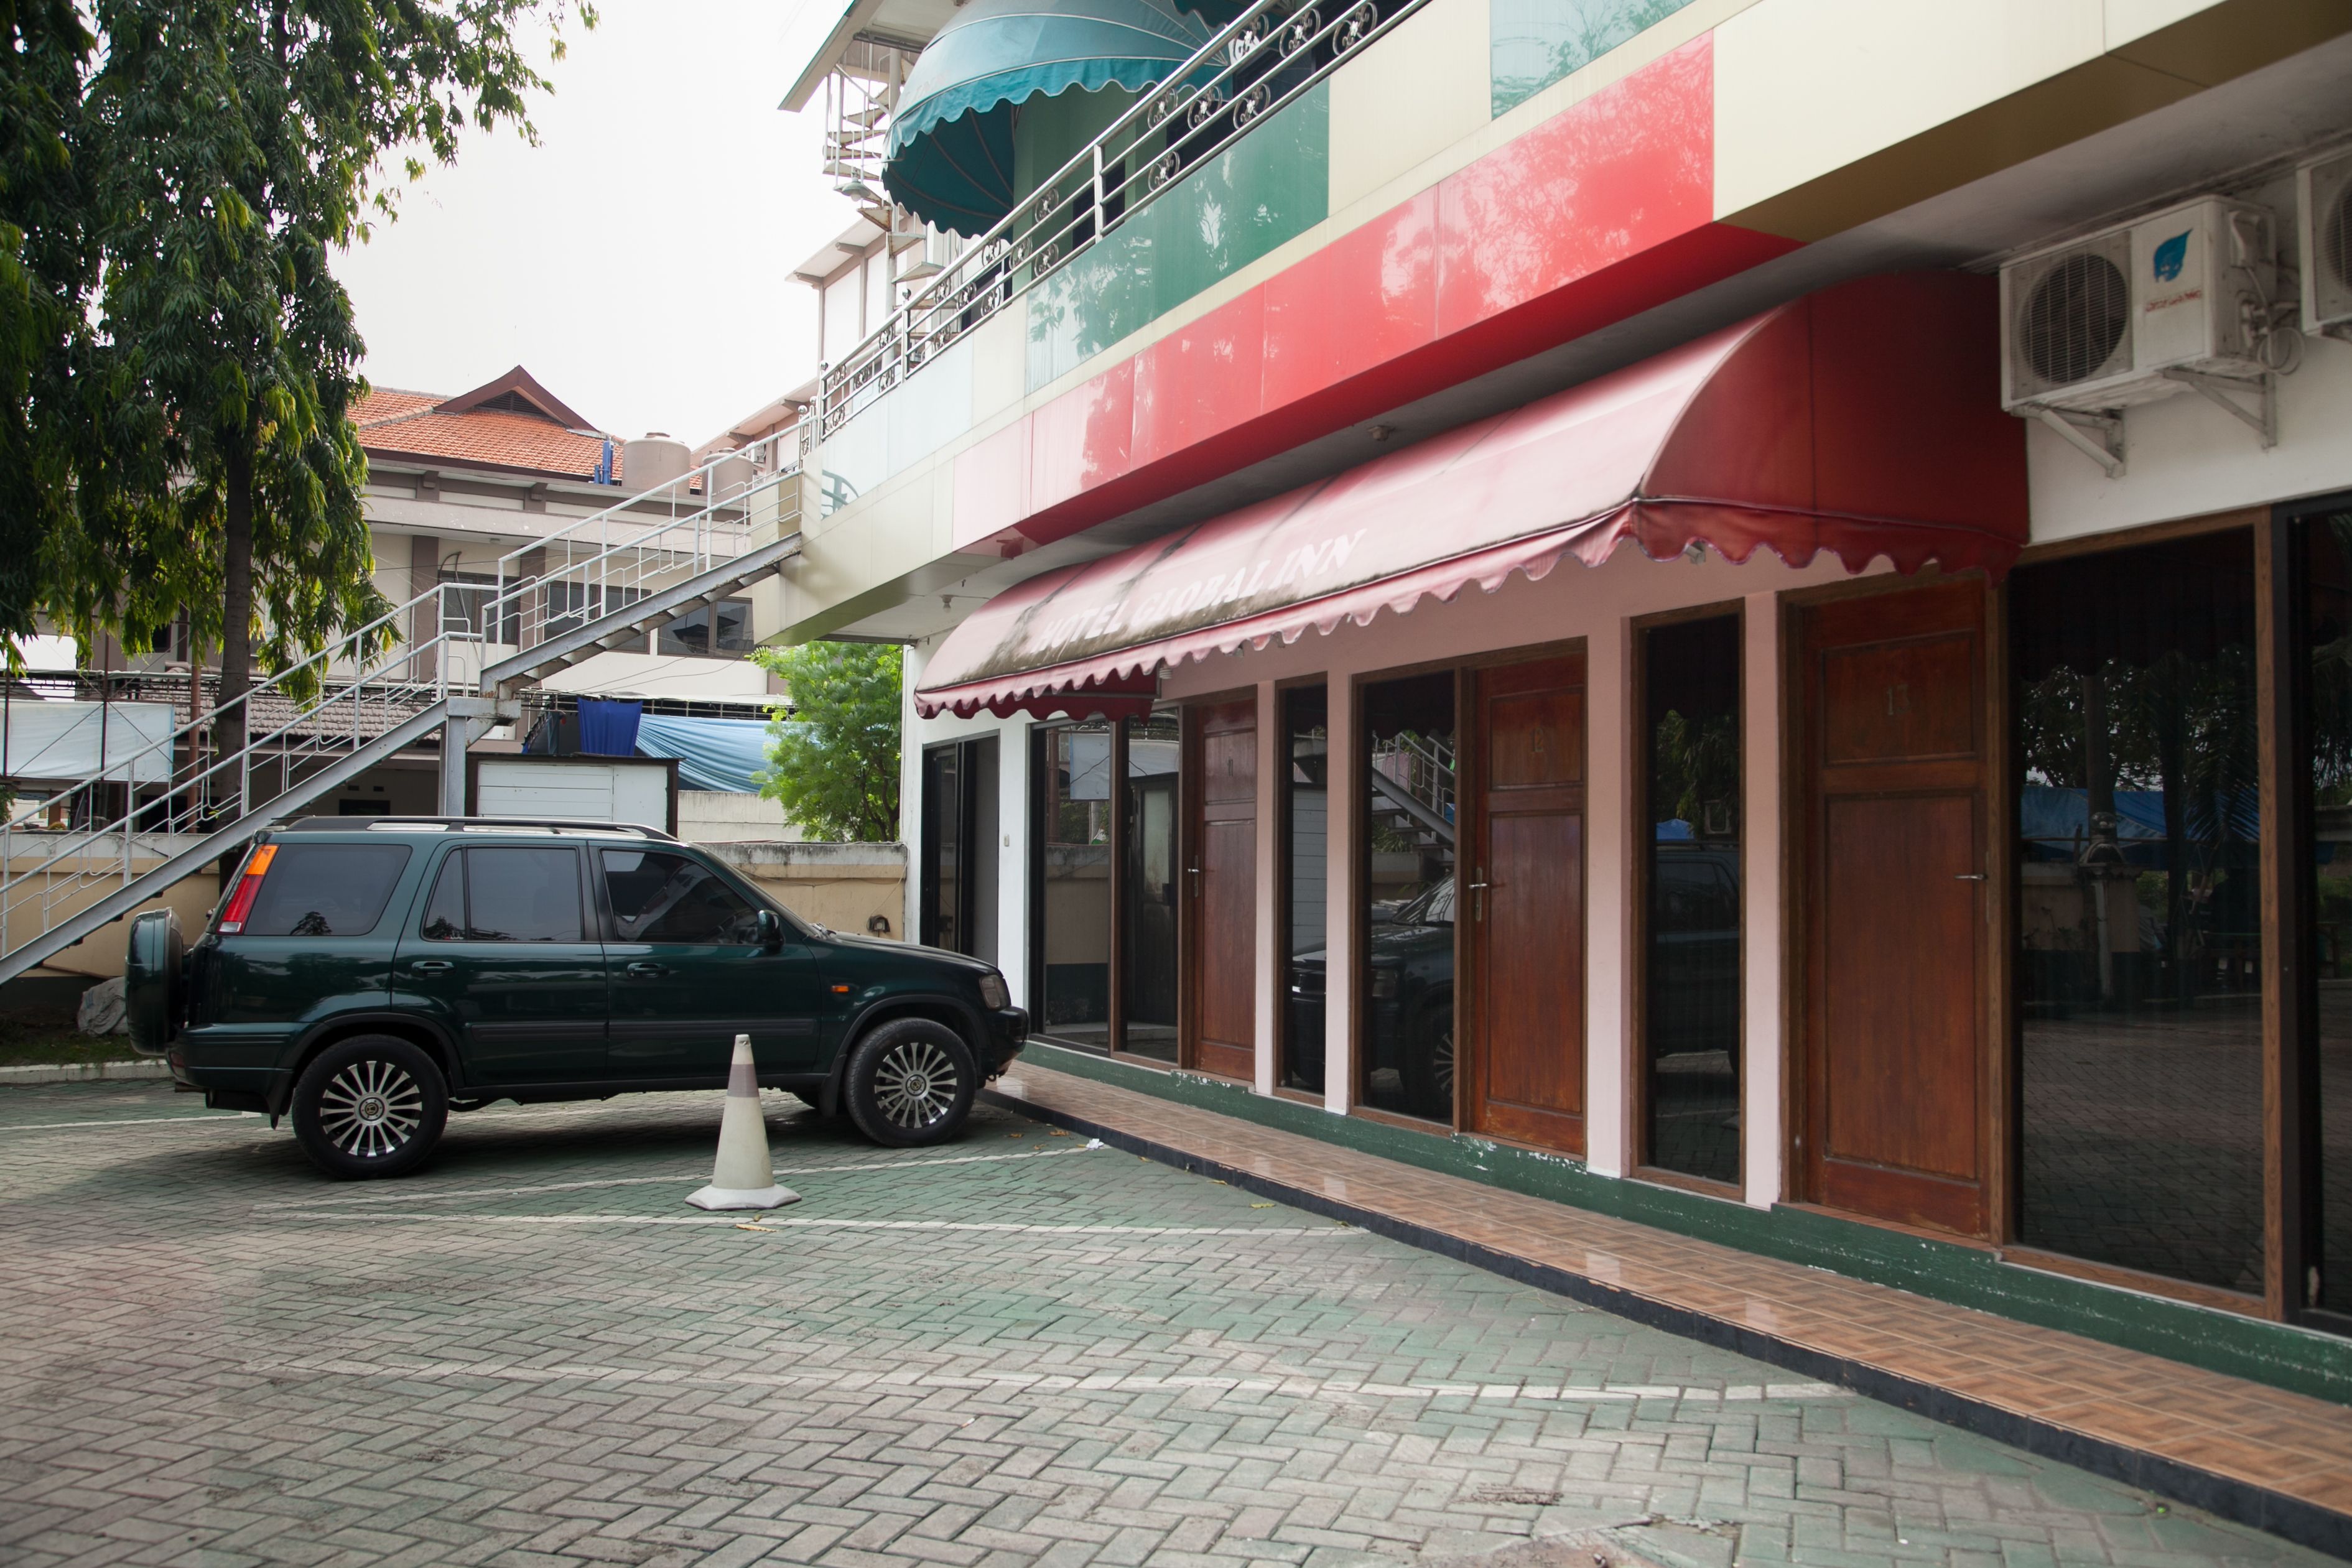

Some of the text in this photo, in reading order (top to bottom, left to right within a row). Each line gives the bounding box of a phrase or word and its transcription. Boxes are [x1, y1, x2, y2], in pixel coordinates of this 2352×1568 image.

[1028, 527, 1368, 654] HOTEL GLOBAL INN
[1886, 684, 1911, 716] 13
